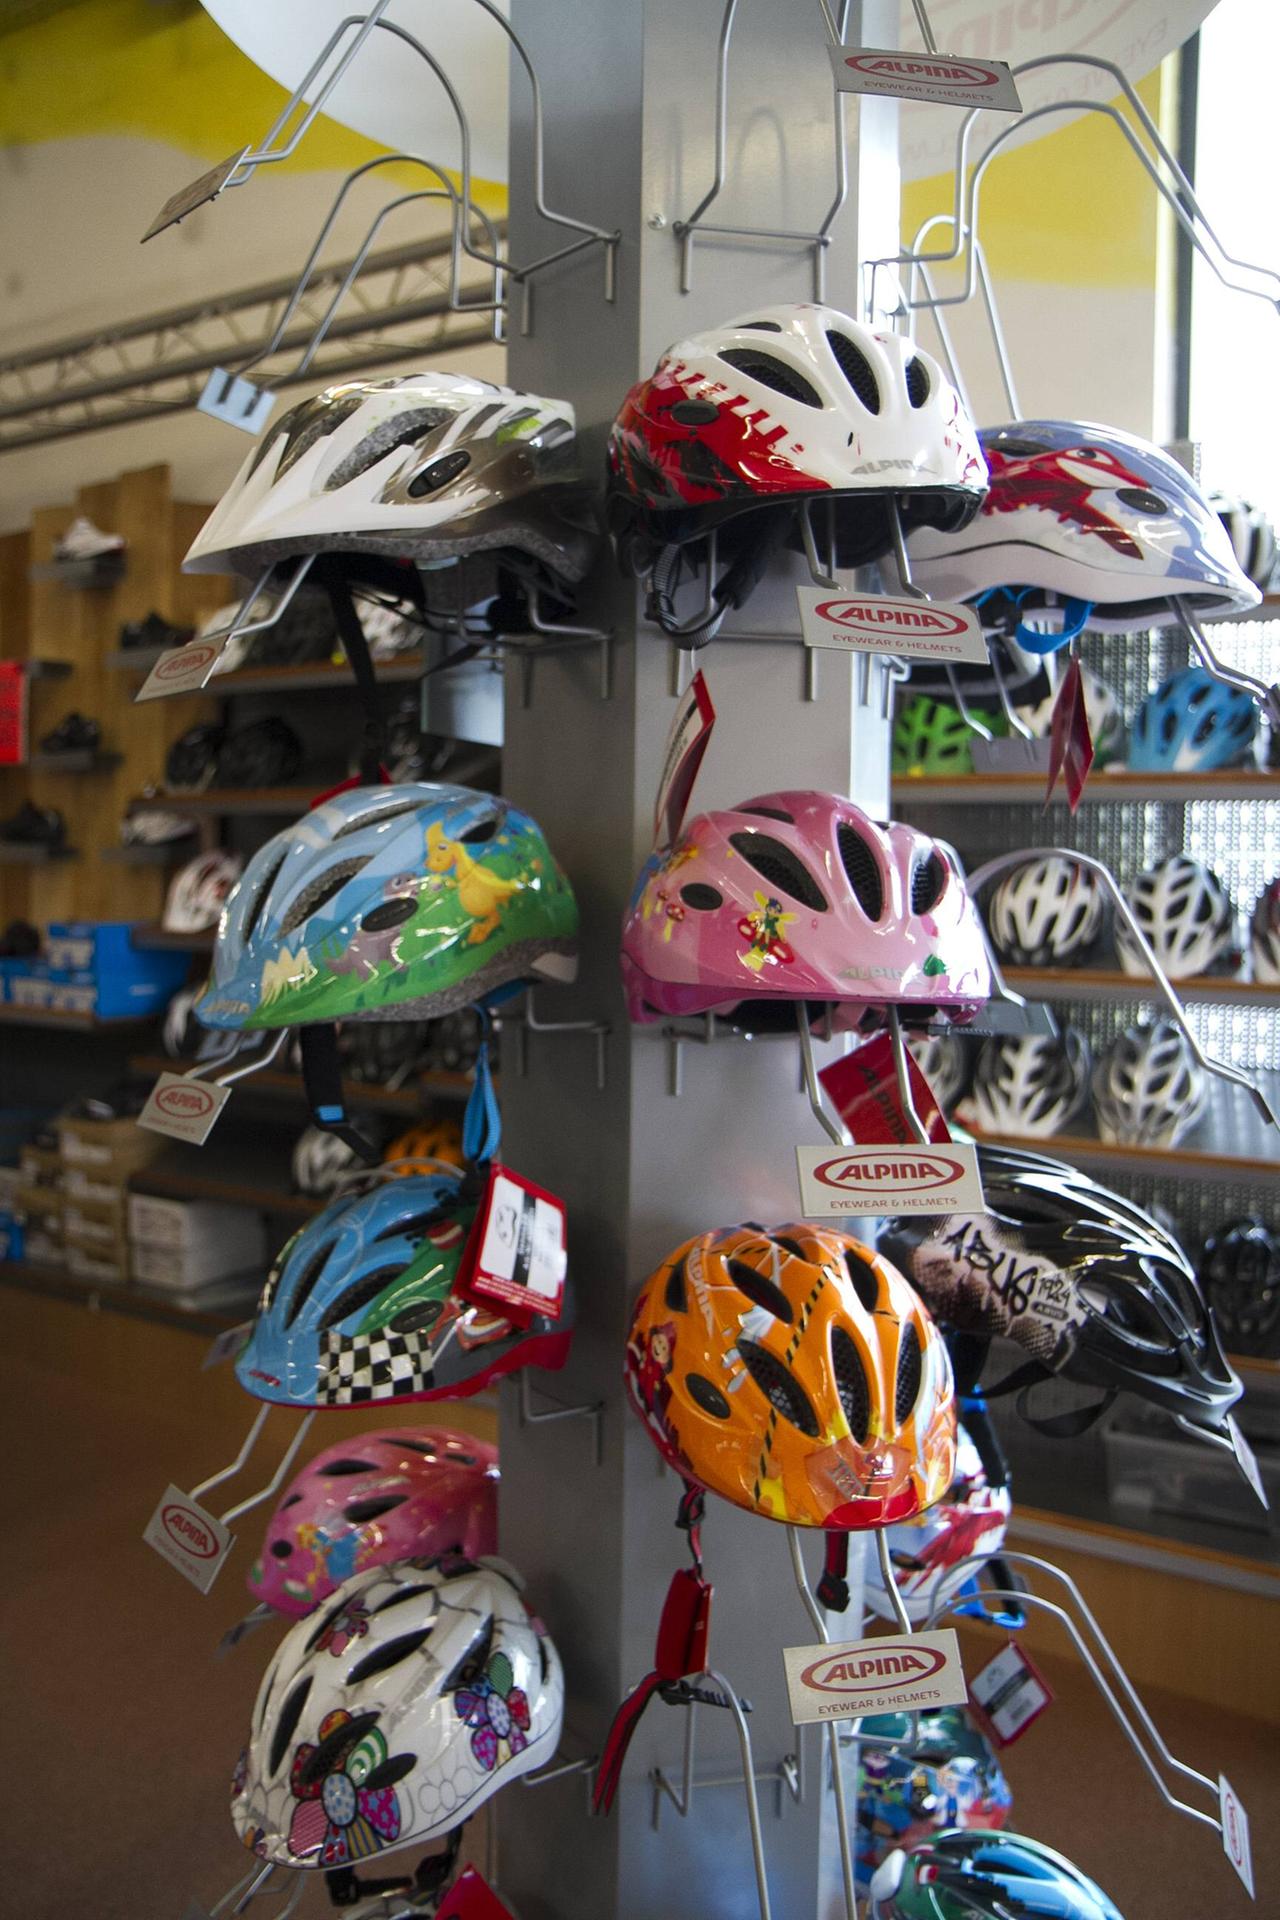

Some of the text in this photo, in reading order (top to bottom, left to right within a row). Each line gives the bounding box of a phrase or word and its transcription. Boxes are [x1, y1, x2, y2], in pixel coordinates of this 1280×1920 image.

[868, 60, 979, 82] ALPINA
[863, 80, 922, 93] EYEWEAR
[938, 89, 994, 101] HELMETS
[837, 607, 950, 630] ALPINA
[832, 633, 962, 653] EYEWEAR & HELMETS
[835, 1162, 947, 1181] ALPINA
[830, 1196, 958, 1210] EYEWEAR & HELMETS
[821, 1654, 929, 1684] ALPINA
[818, 1689, 941, 1714] EYEWEAR & HELMETS
